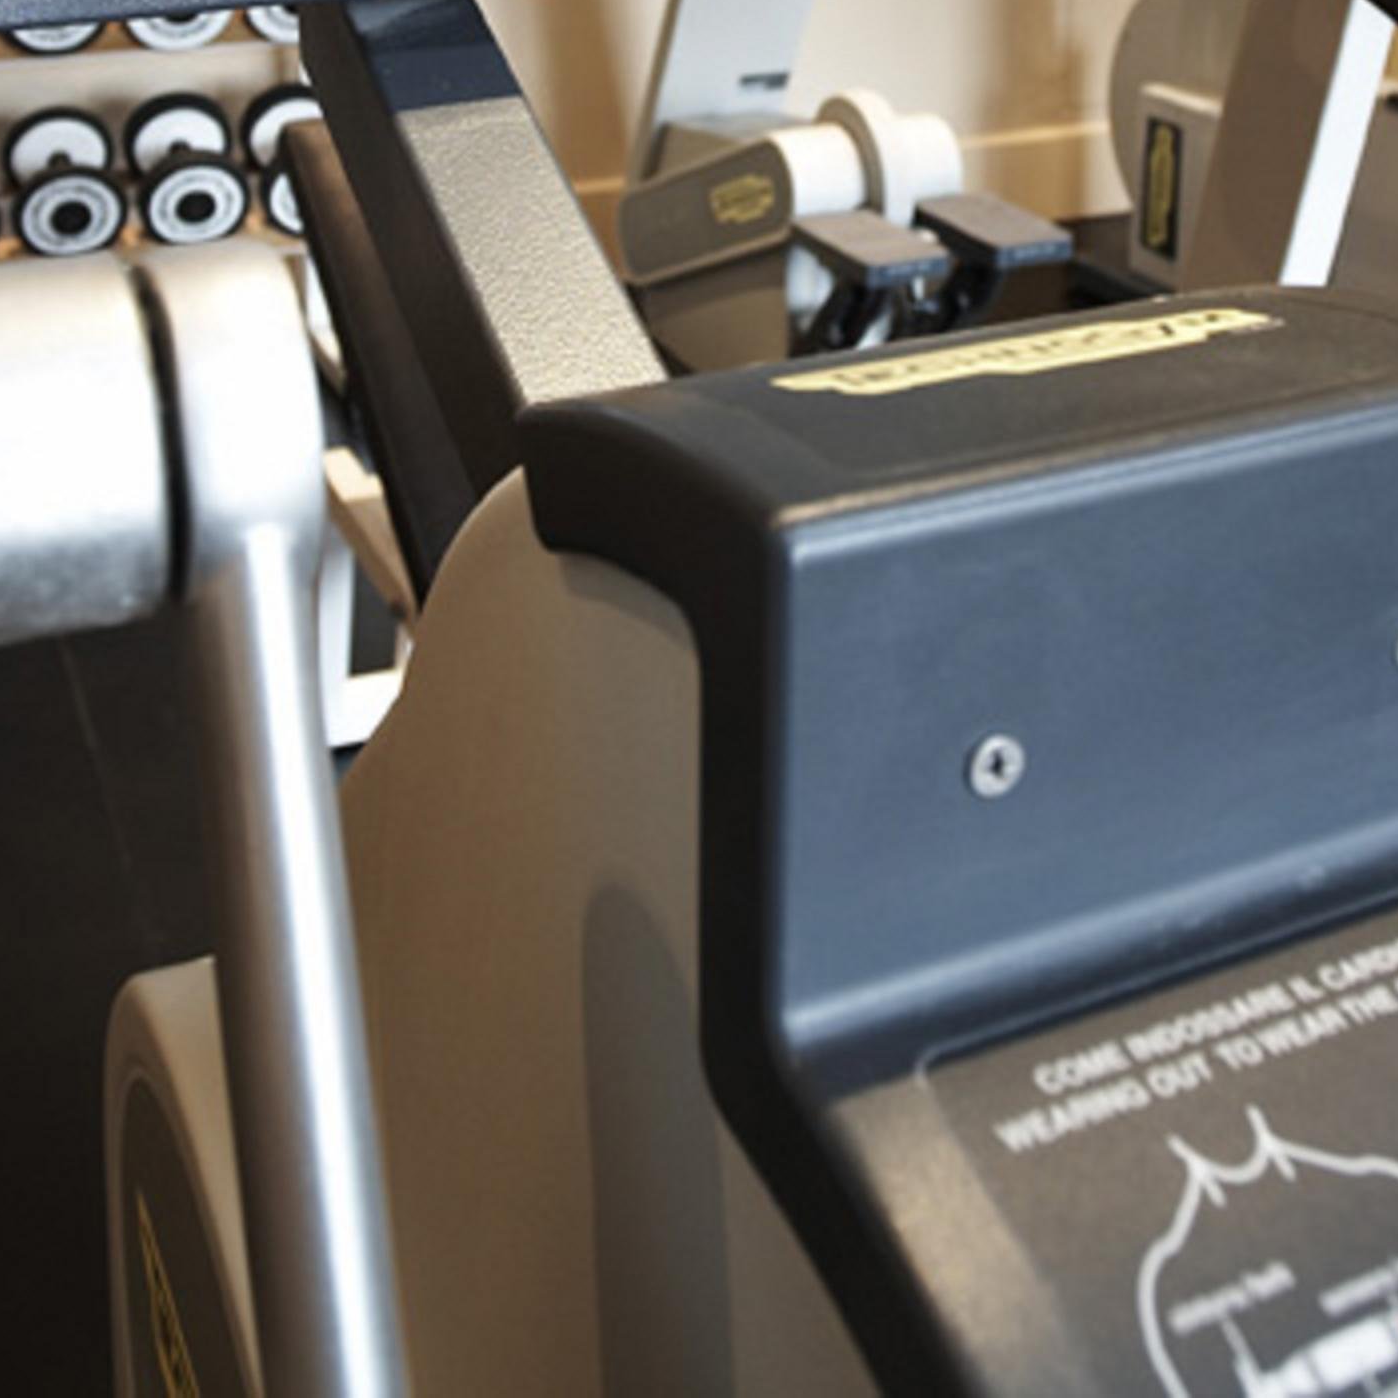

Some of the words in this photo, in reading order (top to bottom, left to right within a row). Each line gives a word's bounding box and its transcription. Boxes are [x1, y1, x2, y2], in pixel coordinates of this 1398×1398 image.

[995, 1076, 1153, 1153] WEARING
[1146, 1050, 1214, 1099] OUT
[1214, 1034, 1264, 1070] TO
[1256, 1004, 1350, 1057] WEAR
[1034, 1042, 1131, 1094] COME
[1124, 980, 1295, 1062] INDOSSARE
